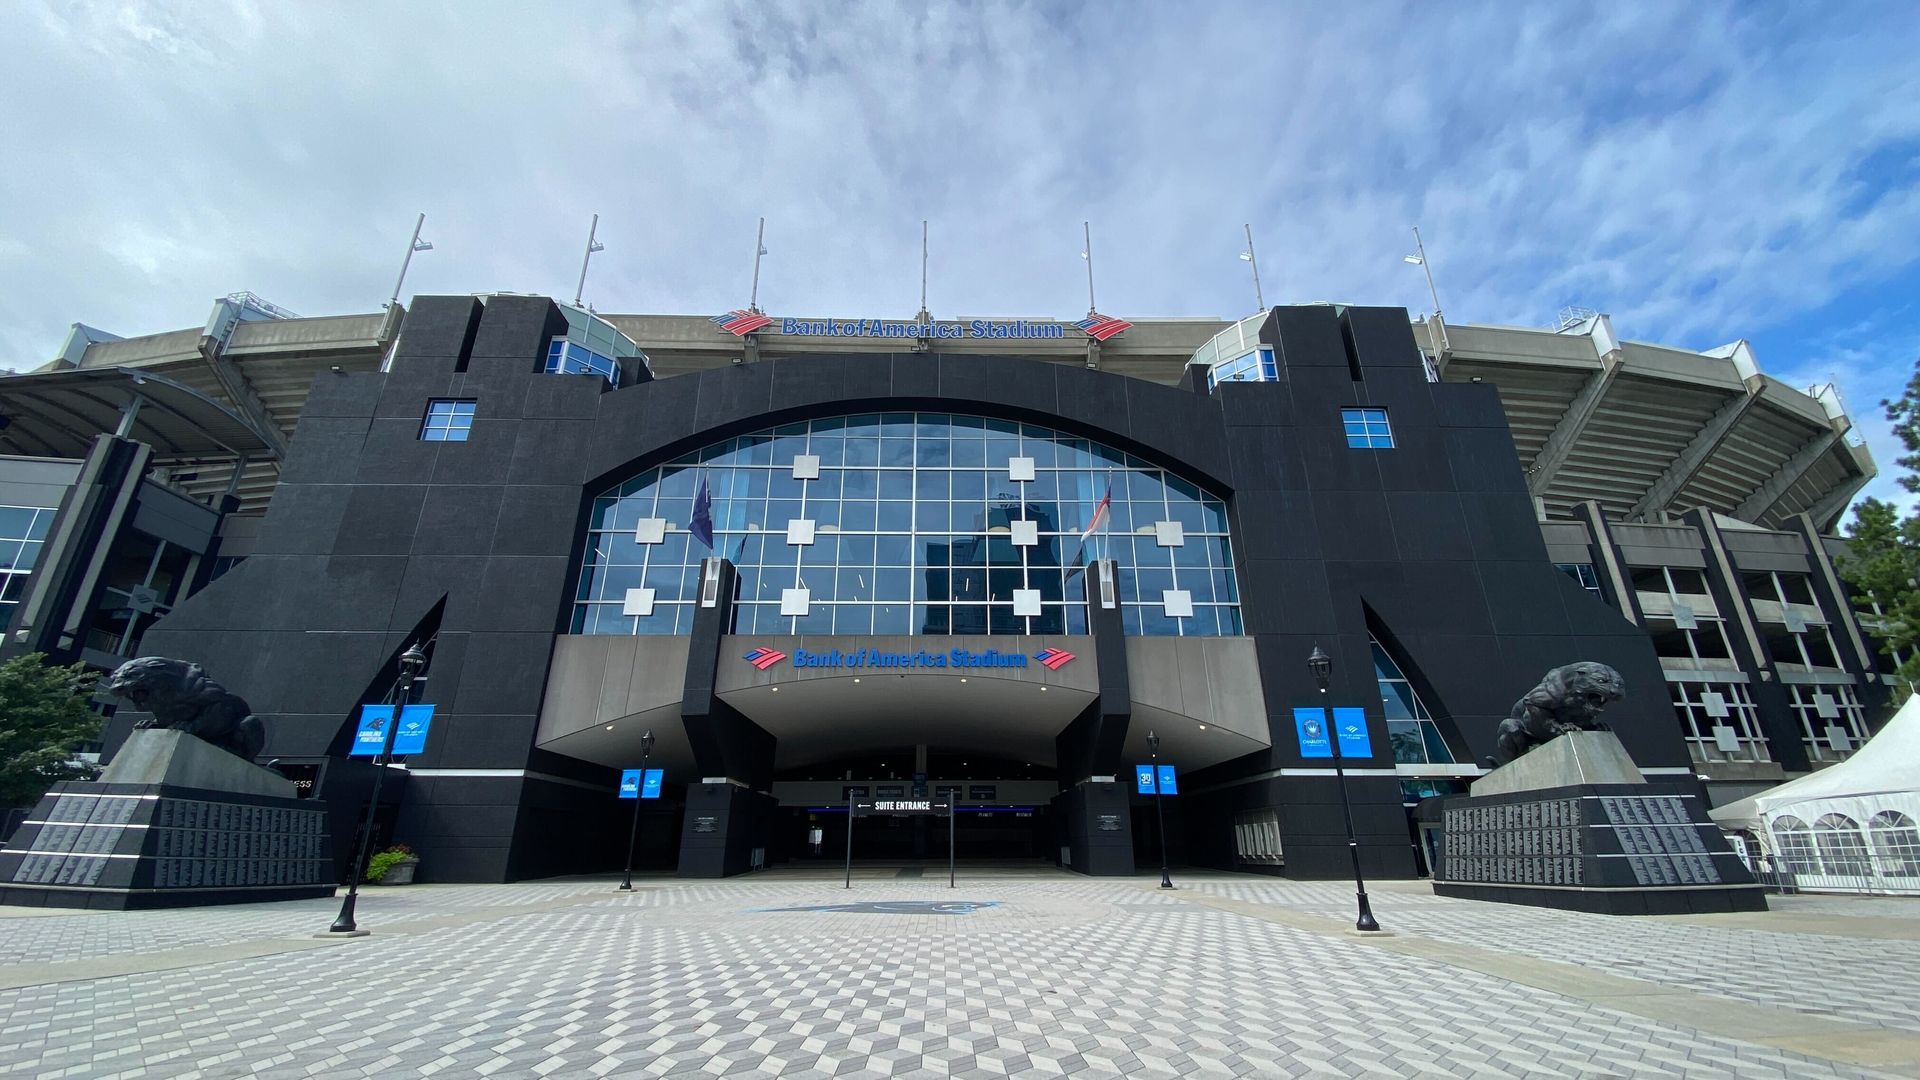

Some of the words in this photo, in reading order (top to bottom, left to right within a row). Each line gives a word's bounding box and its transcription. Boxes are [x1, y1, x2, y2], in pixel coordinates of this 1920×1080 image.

[781, 317, 840, 336] Bank
[843, 316, 866, 337] of
[869, 317, 964, 339] America
[969, 319, 1064, 339] Stadium
[793, 648, 843, 668] Bank
[844, 648, 866, 668] of
[867, 648, 948, 668] America
[949, 648, 1027, 668] Stadium
[875, 801, 895, 810] SUITE
[896, 801, 930, 810] ENTRANCE
